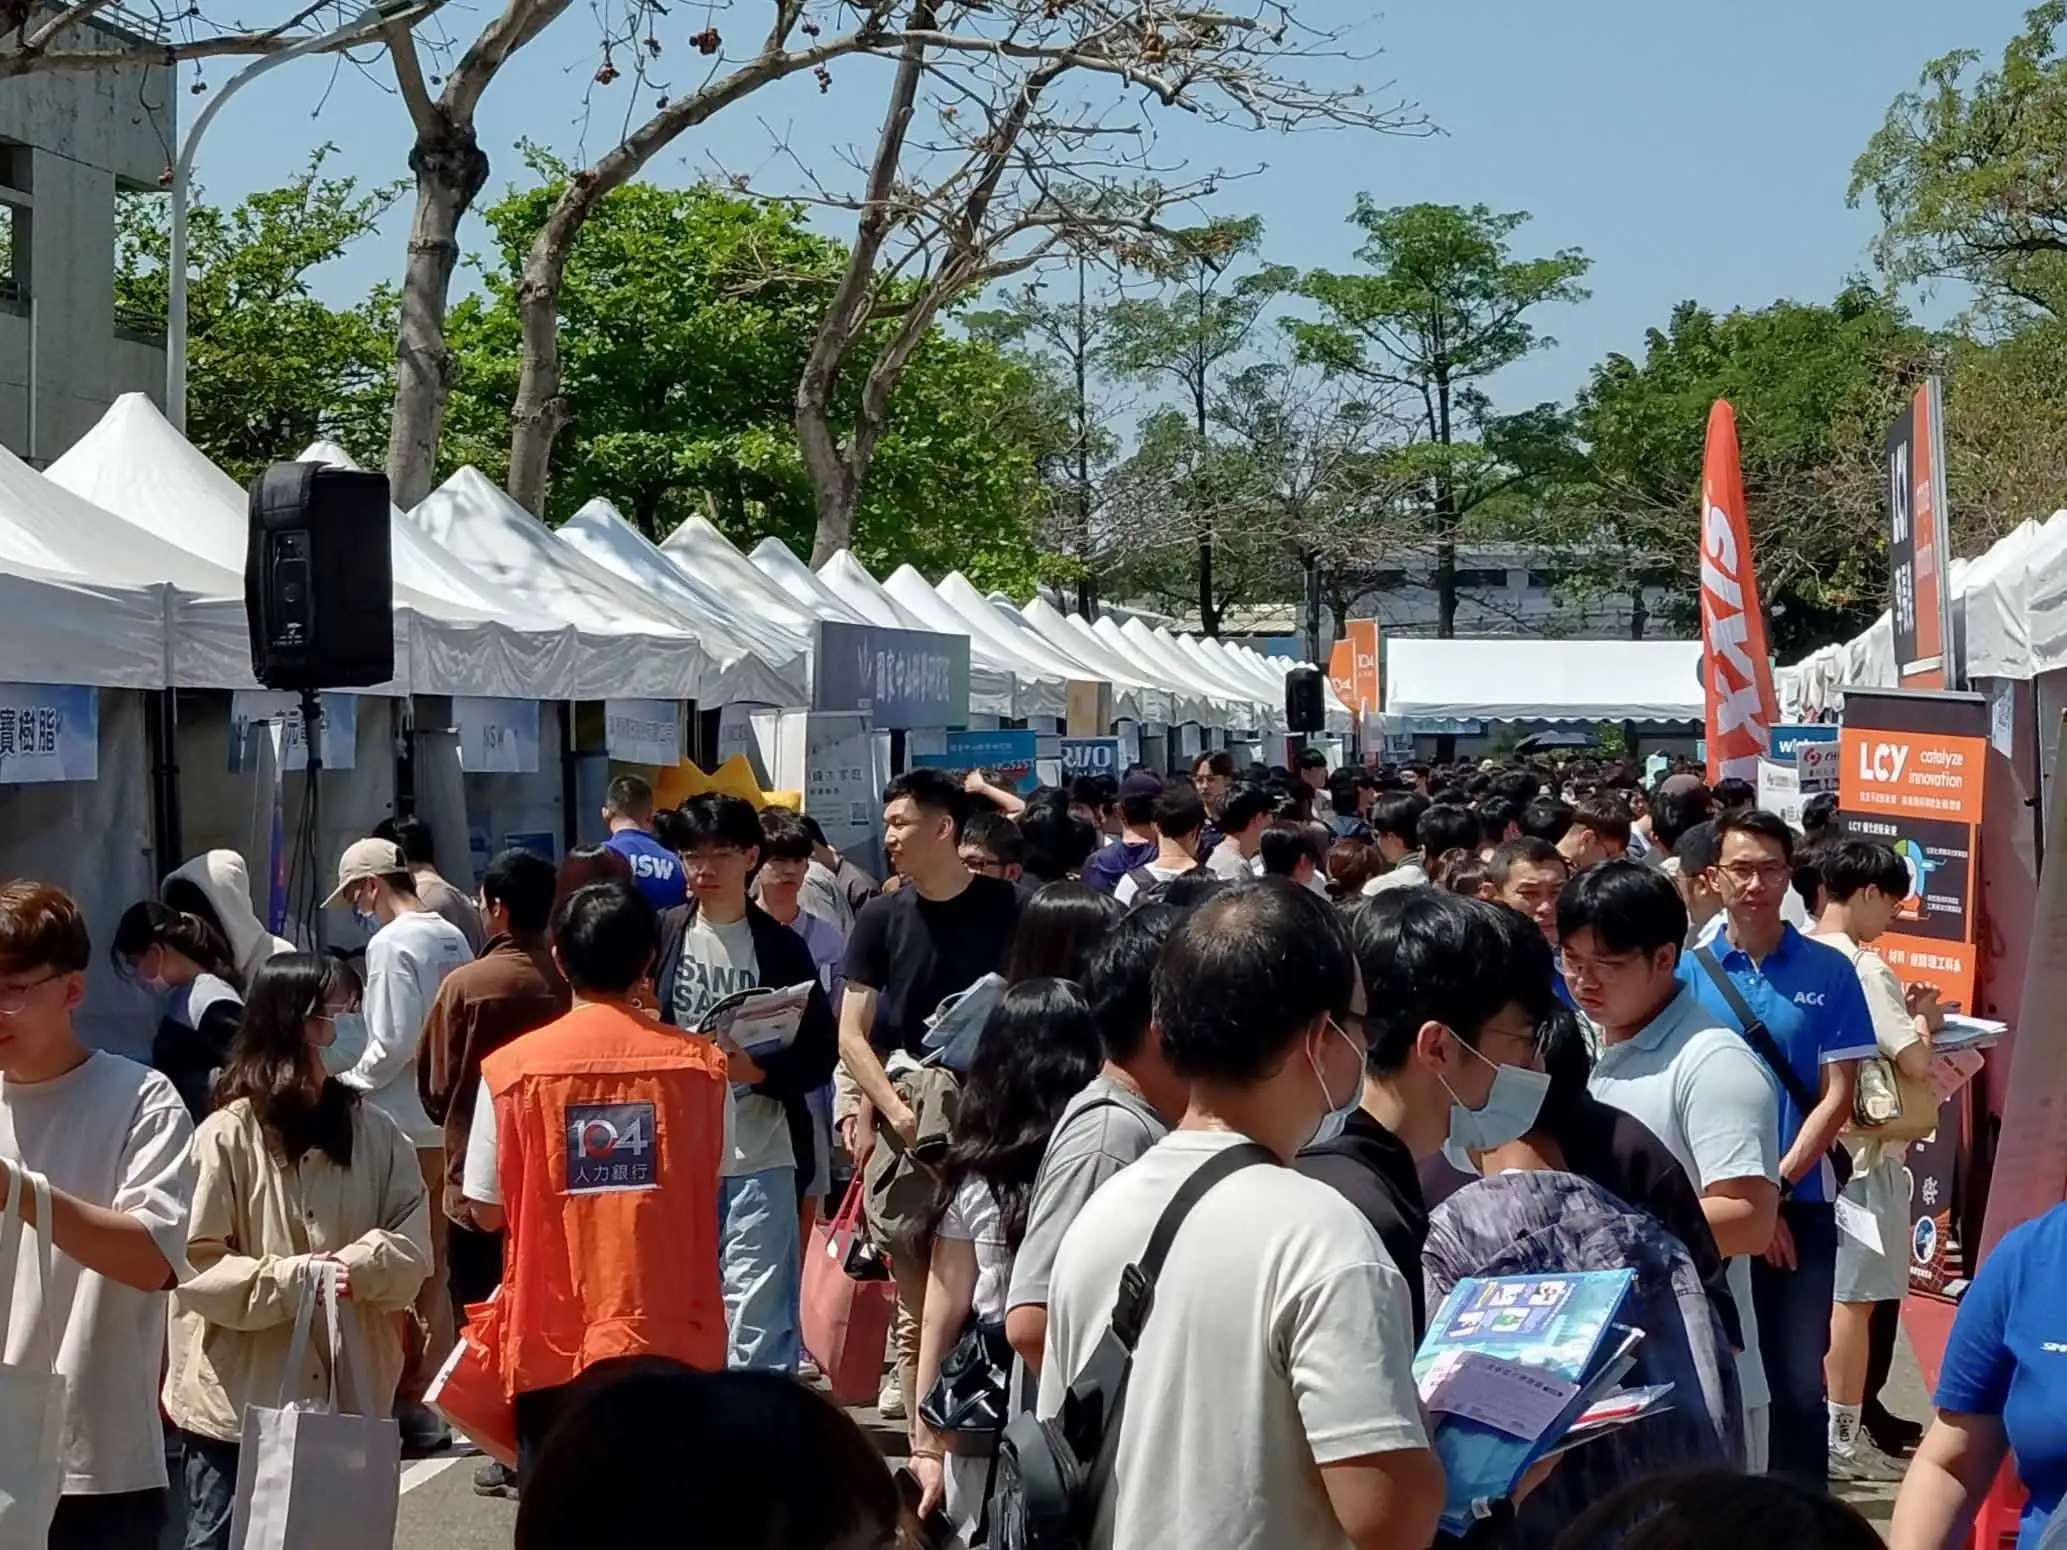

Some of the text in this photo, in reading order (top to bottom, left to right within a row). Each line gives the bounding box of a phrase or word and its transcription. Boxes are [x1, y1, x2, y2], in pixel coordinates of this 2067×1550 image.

[1859, 741, 1909, 783] LCY
[1920, 747, 1964, 769] catalyze
[1908, 768, 1963, 790] innovation
[567, 1117, 649, 1159] 104
[574, 1163, 649, 1184] 人力銀行
